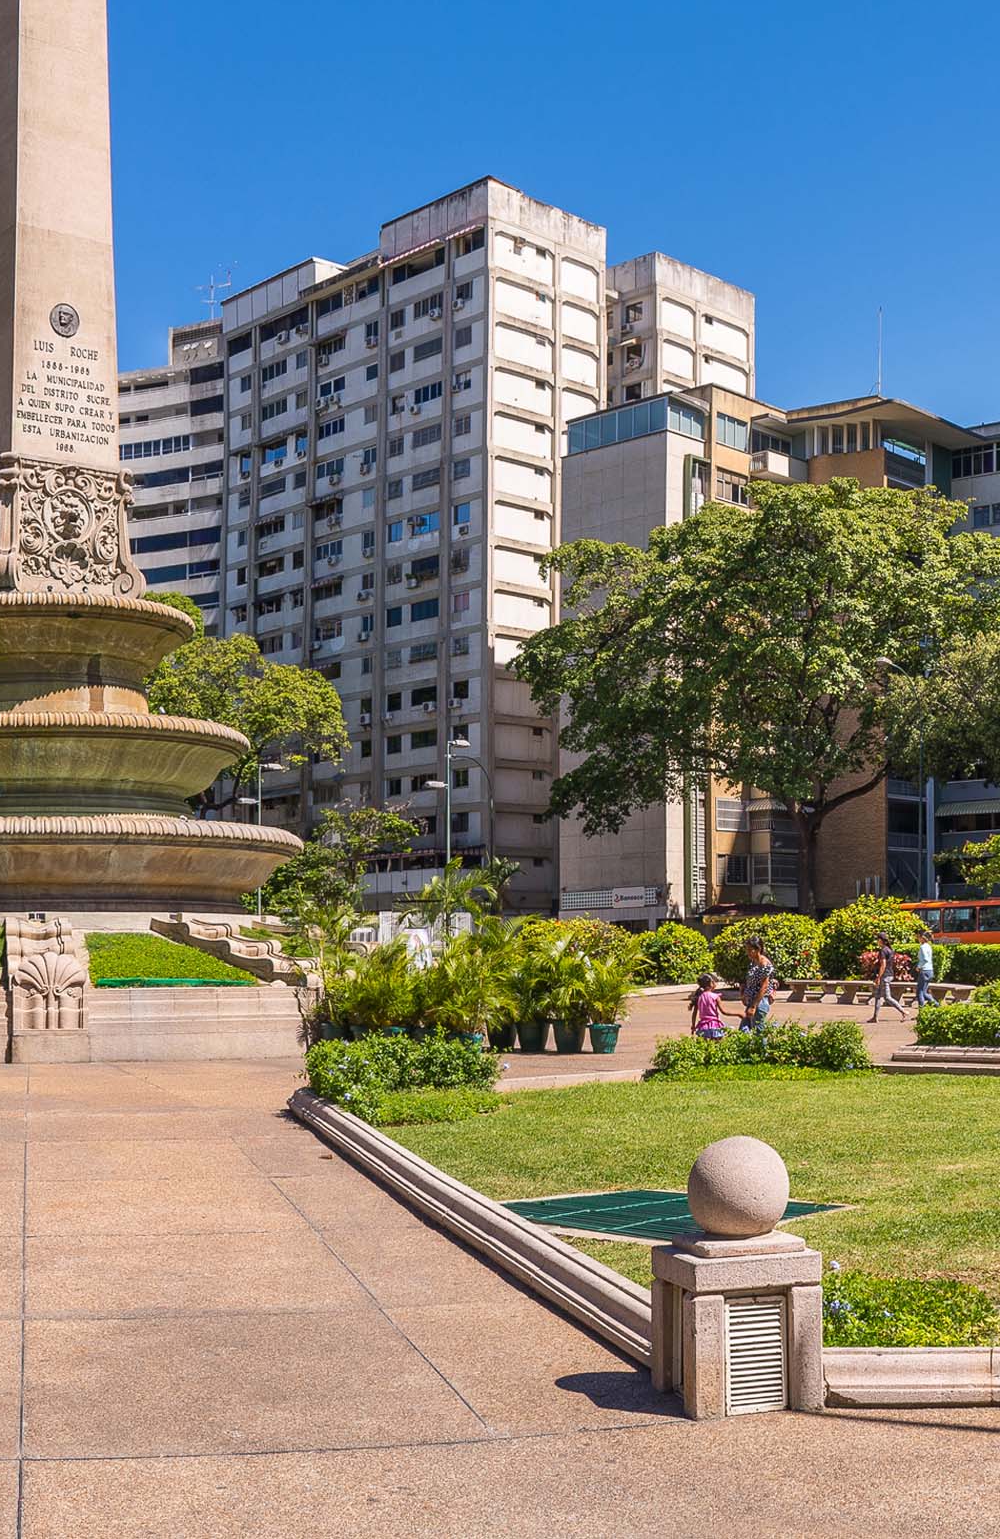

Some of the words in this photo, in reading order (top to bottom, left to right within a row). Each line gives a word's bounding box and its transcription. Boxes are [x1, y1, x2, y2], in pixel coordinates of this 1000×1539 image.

[33, 340, 55, 353] LUIS
[70, 347, 99, 361] ROCHE
[26, 371, 37, 381] LA
[46, 375, 105, 392] MUNICIPALIDAD
[21, 384, 36, 394] DEL
[43, 387, 79, 401] DISTRITO
[18, 397, 24, 406] A
[28, 398, 50, 409] QUIEN
[55, 402, 75, 414] SUPO
[79, 406, 104, 419] CREAR
[108, 411, 114, 421] Y
[16, 410, 63, 425] EMBELLECER
[66, 417, 87, 430] PARA
[92, 421, 116, 434] TODOS
[22, 424, 42, 435] ESTA
[49, 428, 109, 445] URBANIZACION
